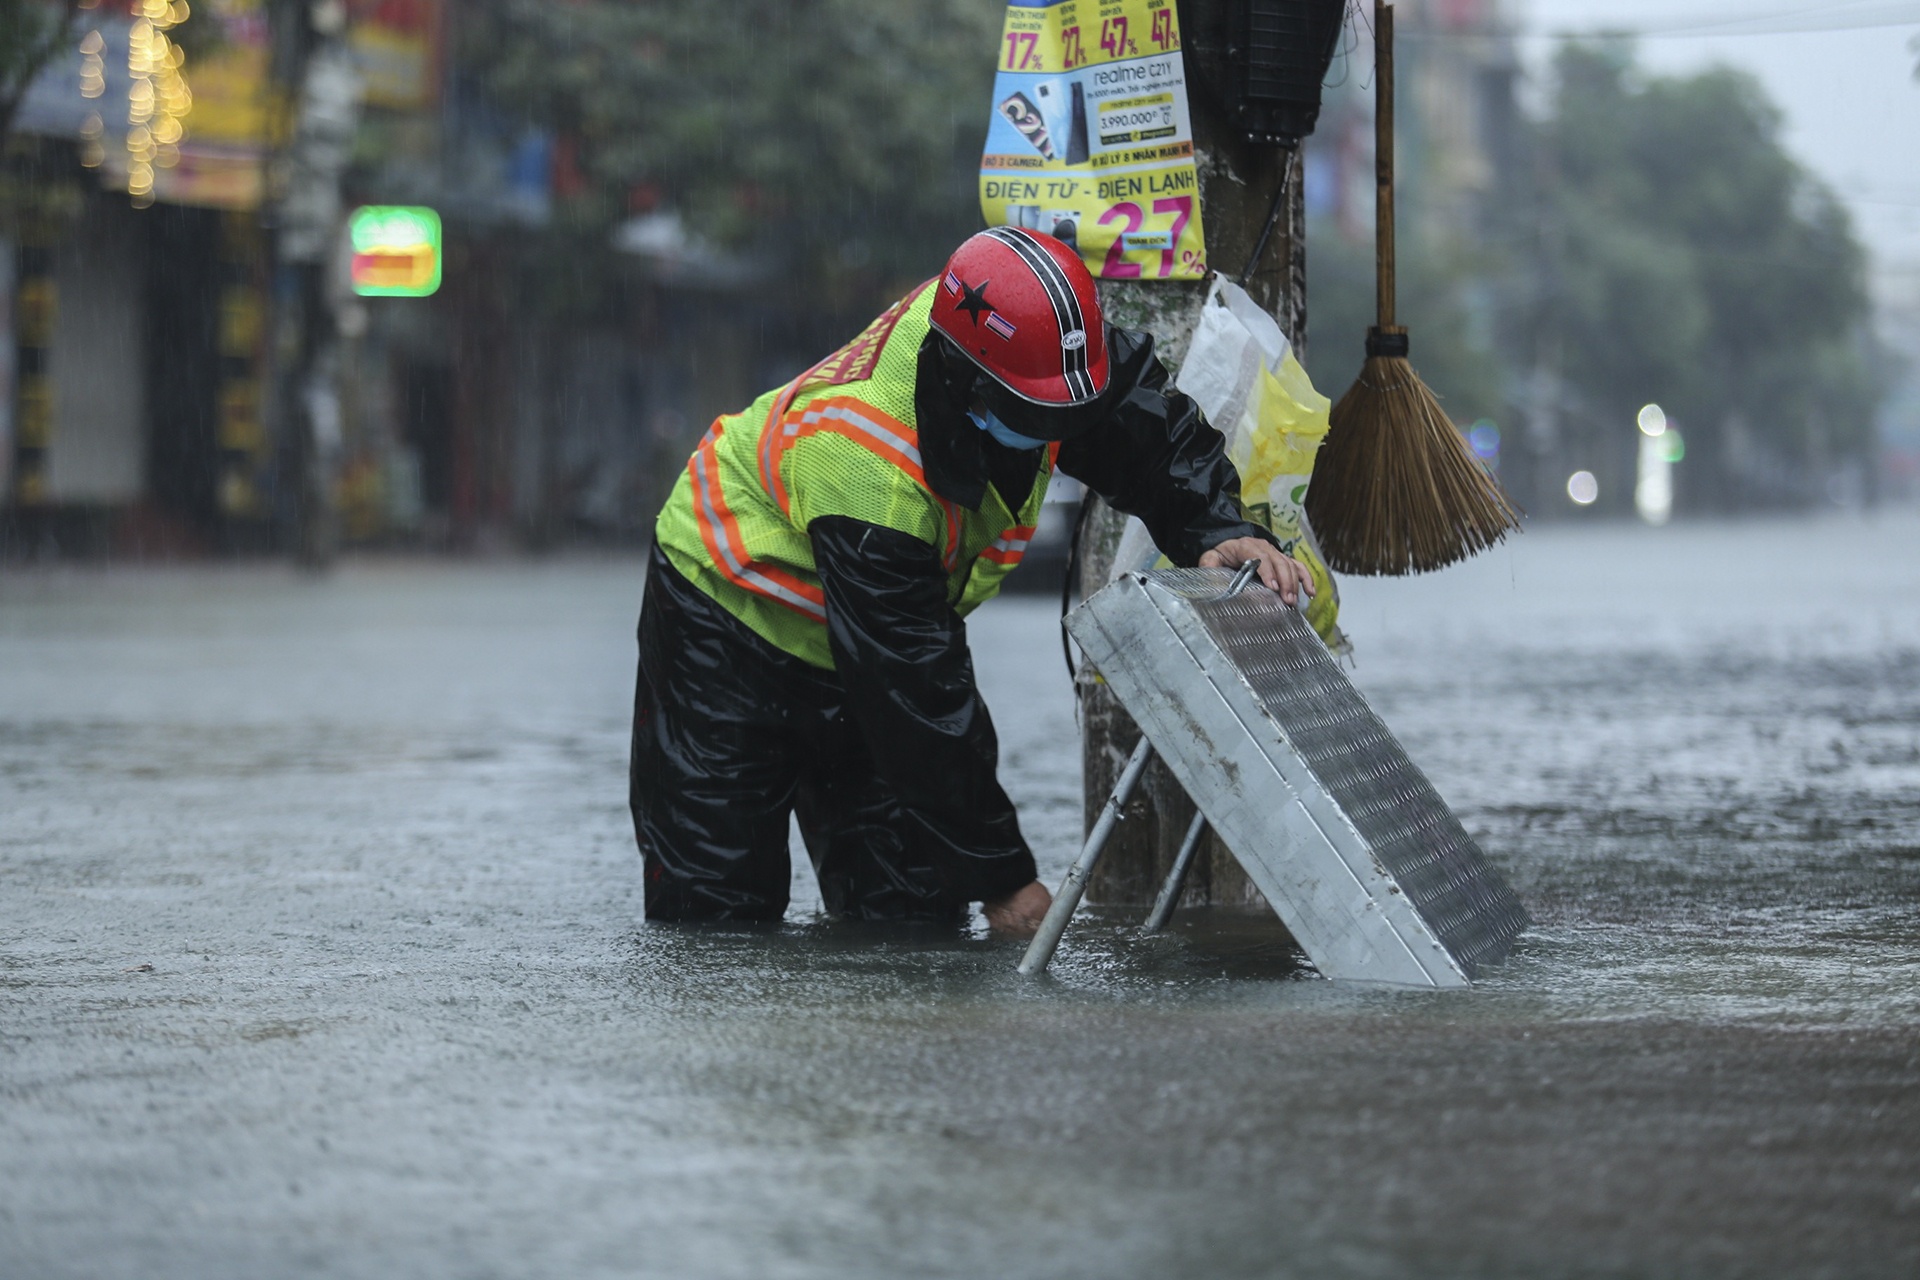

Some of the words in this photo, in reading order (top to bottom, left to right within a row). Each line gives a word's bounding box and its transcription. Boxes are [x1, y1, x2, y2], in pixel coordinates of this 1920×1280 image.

[1100, 16, 1138, 58] 47%
[1094, 66, 1146, 86] realme
[1149, 62, 1172, 78] C21Y
[1007, 157, 1044, 168] CAMERA
[986, 179, 1039, 202] ĐIỆN
[1047, 178, 1079, 200] TỬ
[1097, 176, 1143, 202] ĐIỆN
[1149, 170, 1195, 196] LẠNH
